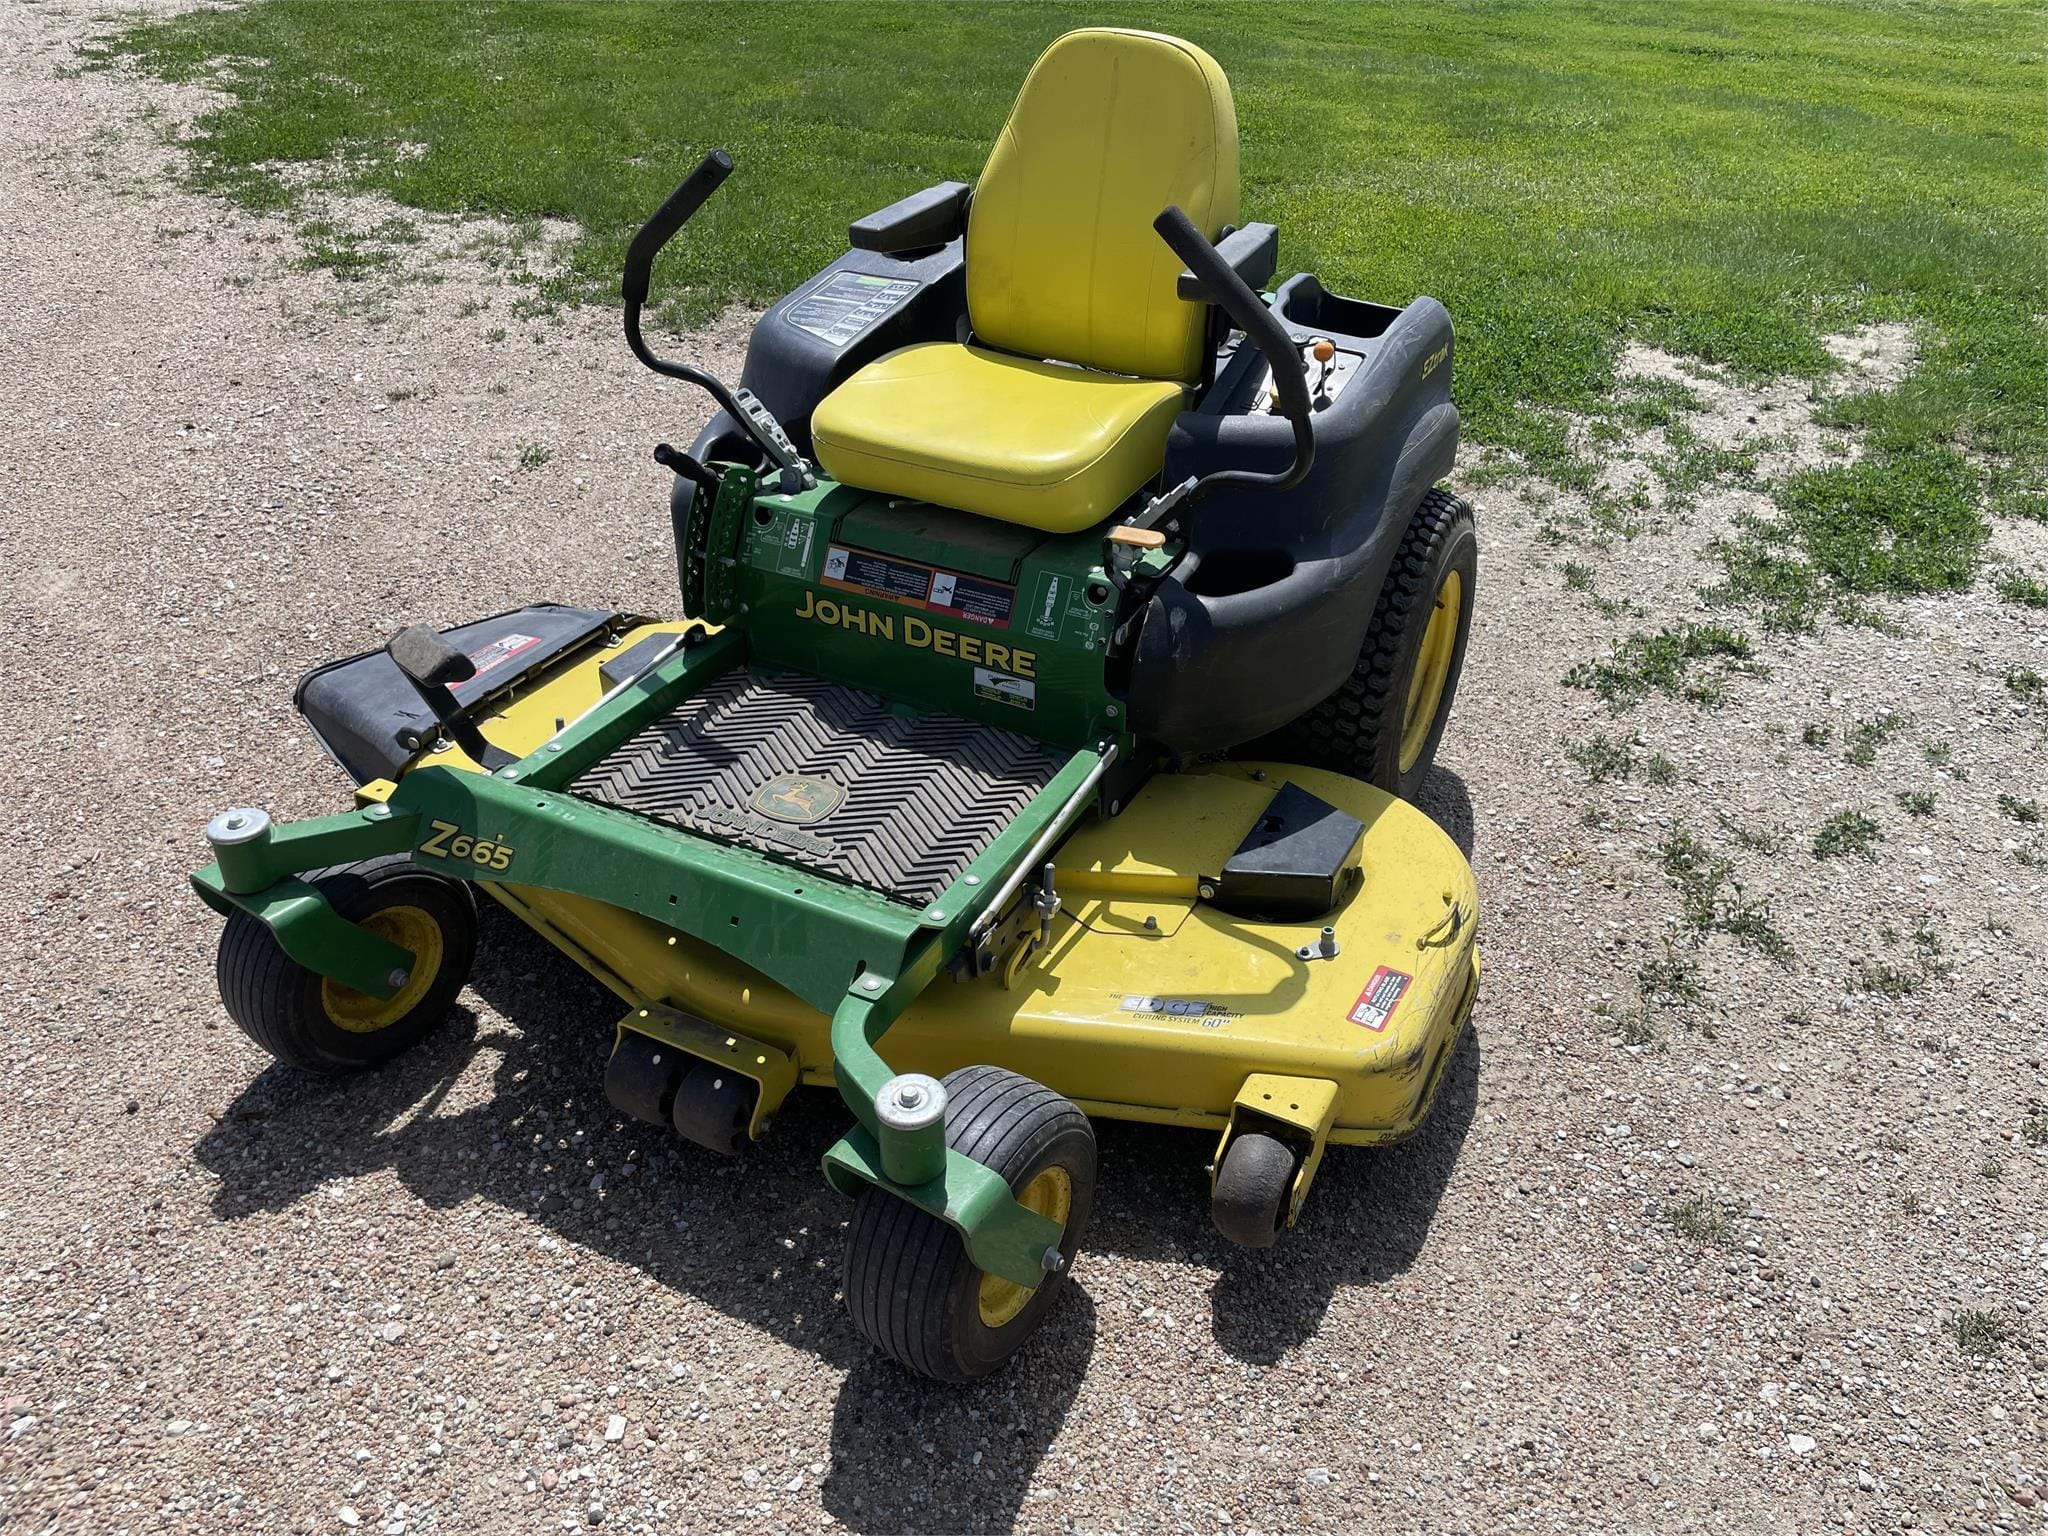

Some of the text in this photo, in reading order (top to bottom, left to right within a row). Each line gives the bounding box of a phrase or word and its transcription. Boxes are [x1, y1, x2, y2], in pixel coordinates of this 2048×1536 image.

[864, 587, 895, 601] WARNING
[962, 611, 988, 624] DANGER
[795, 590, 895, 642] JOHN
[903, 615, 1038, 679] DEERE
[695, 805, 837, 858] JOHN DEERE
[419, 818, 514, 871] Z665
[1120, 994, 1210, 1018] EDGE
[1209, 1004, 1229, 1012] HIGH
[1206, 1010, 1245, 1019] CAPACITY
[1132, 1013, 1167, 1022] CUTTING
[1168, 1017, 1201, 1025] SYSTEM
